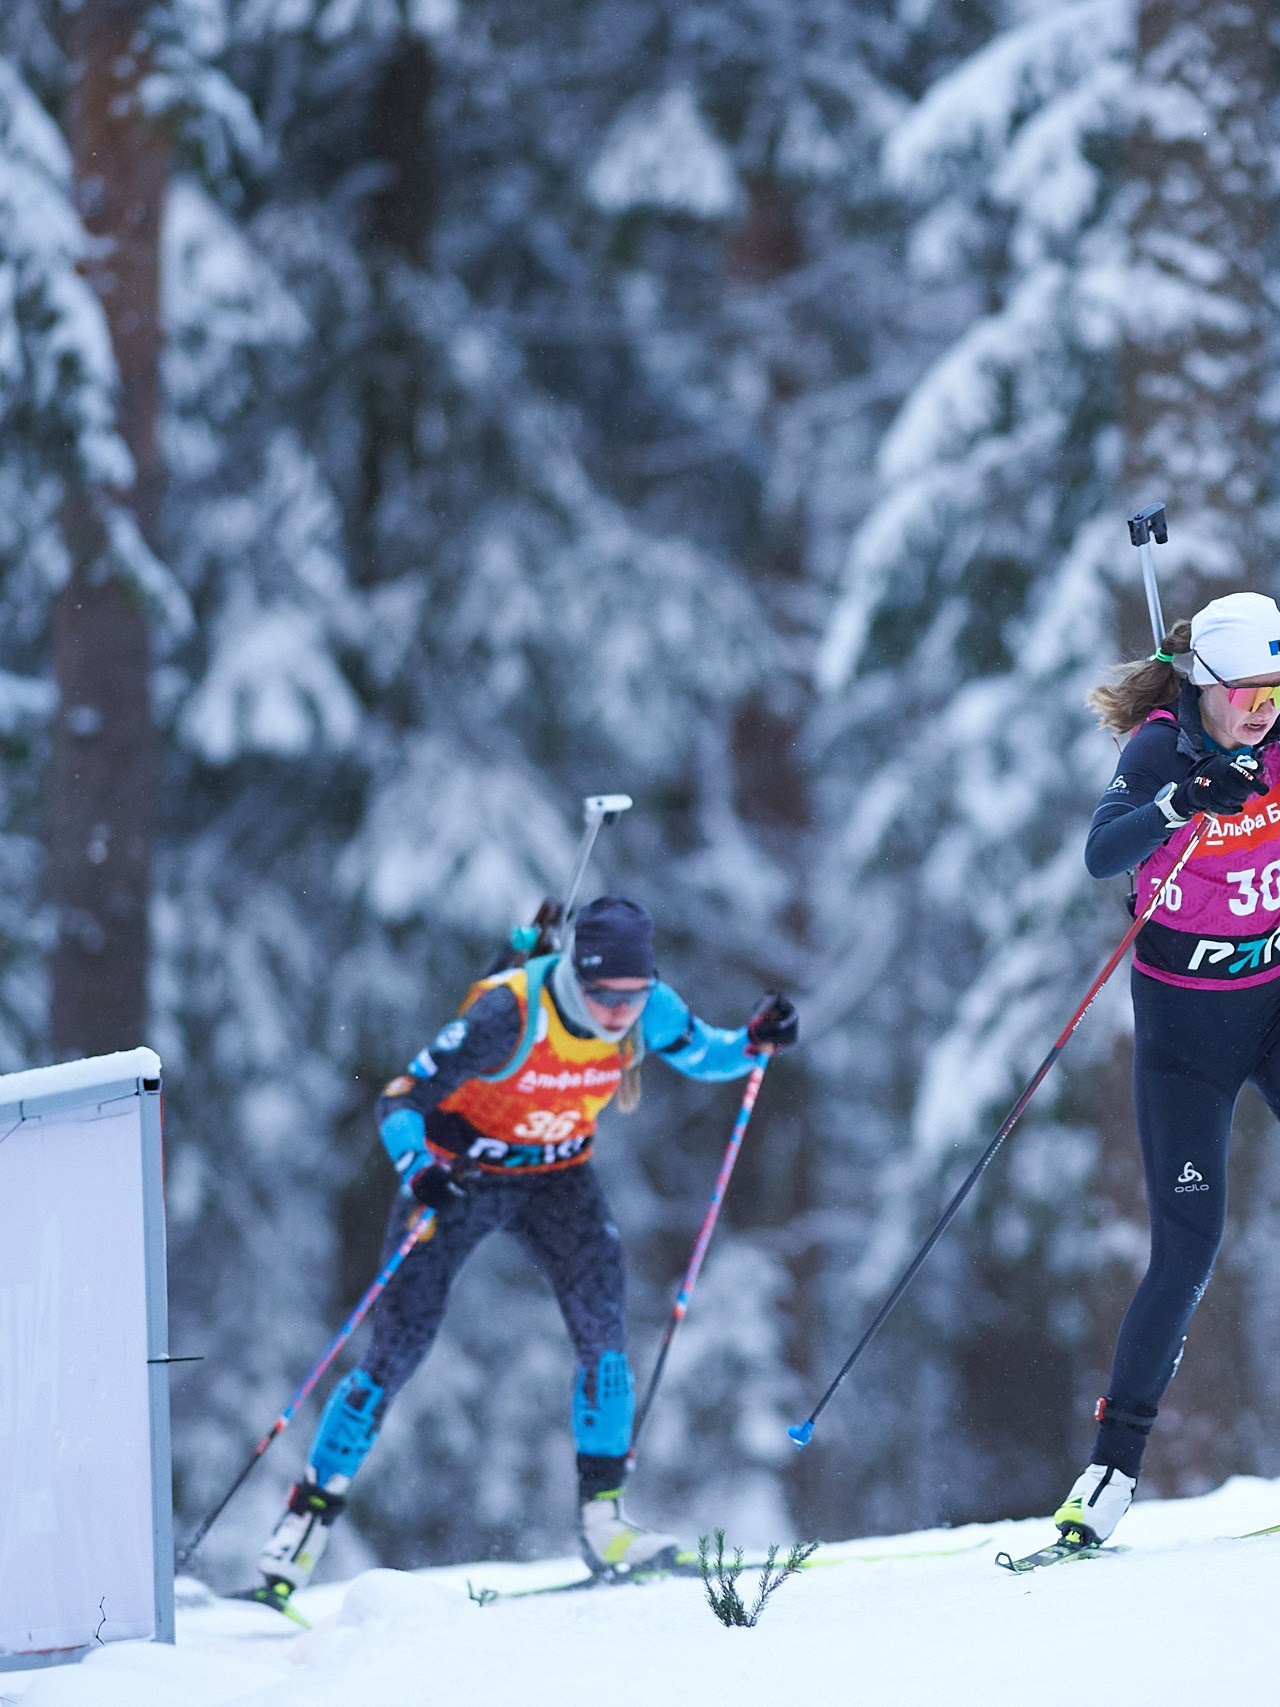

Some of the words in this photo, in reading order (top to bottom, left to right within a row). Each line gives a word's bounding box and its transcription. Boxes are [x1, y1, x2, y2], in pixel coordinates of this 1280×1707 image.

[1206, 814, 1267, 839] Альфа
[513, 1109, 582, 1142] 36
[1174, 1183, 1210, 1193] odlo
